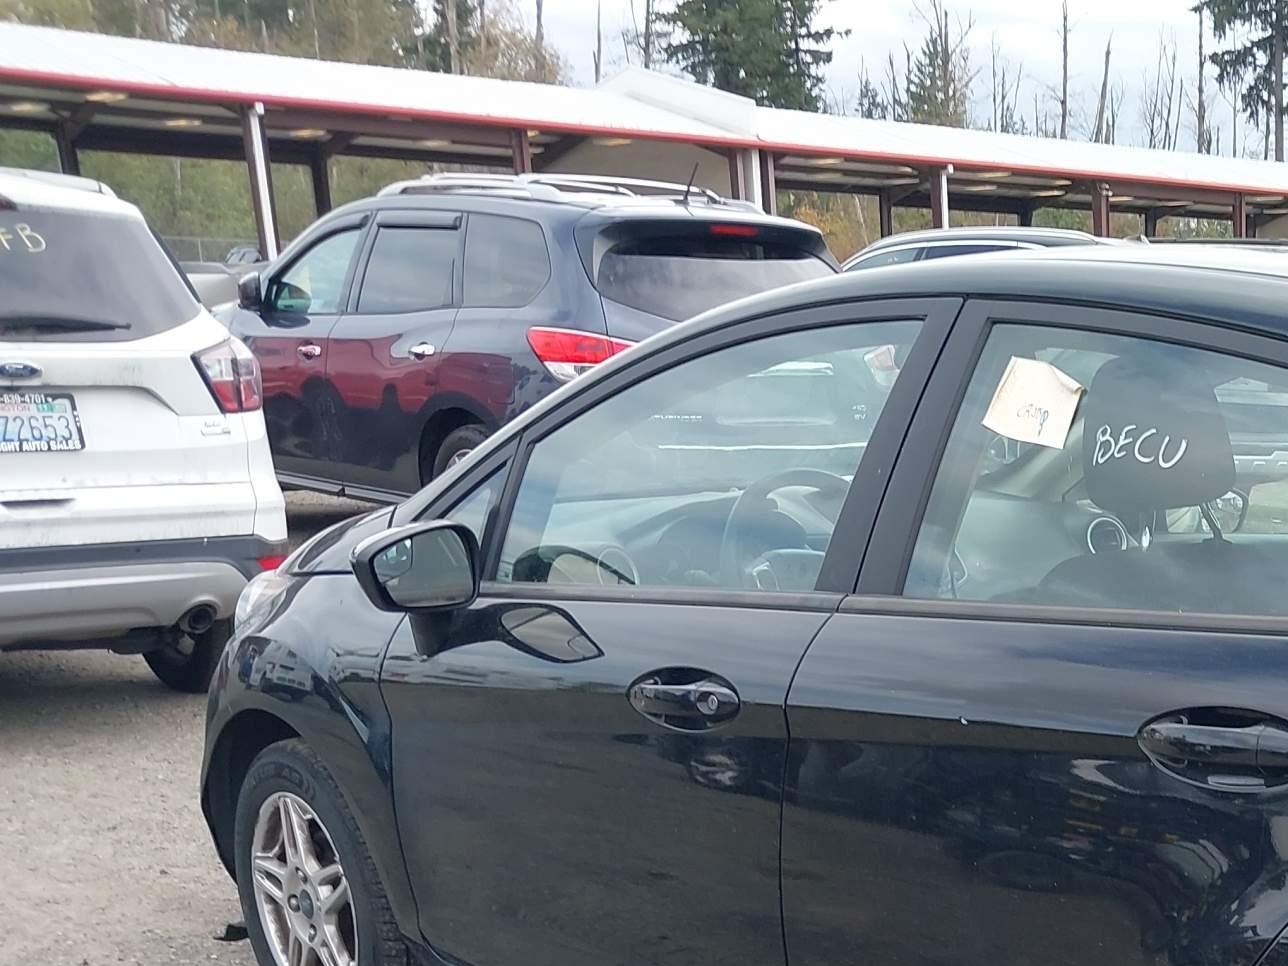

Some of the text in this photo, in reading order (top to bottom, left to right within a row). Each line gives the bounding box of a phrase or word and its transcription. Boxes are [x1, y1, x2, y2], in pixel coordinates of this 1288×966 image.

[22, 440, 49, 451] AUTO
[50, 439, 82, 451] SALES
[1092, 424, 1188, 468] BECU
